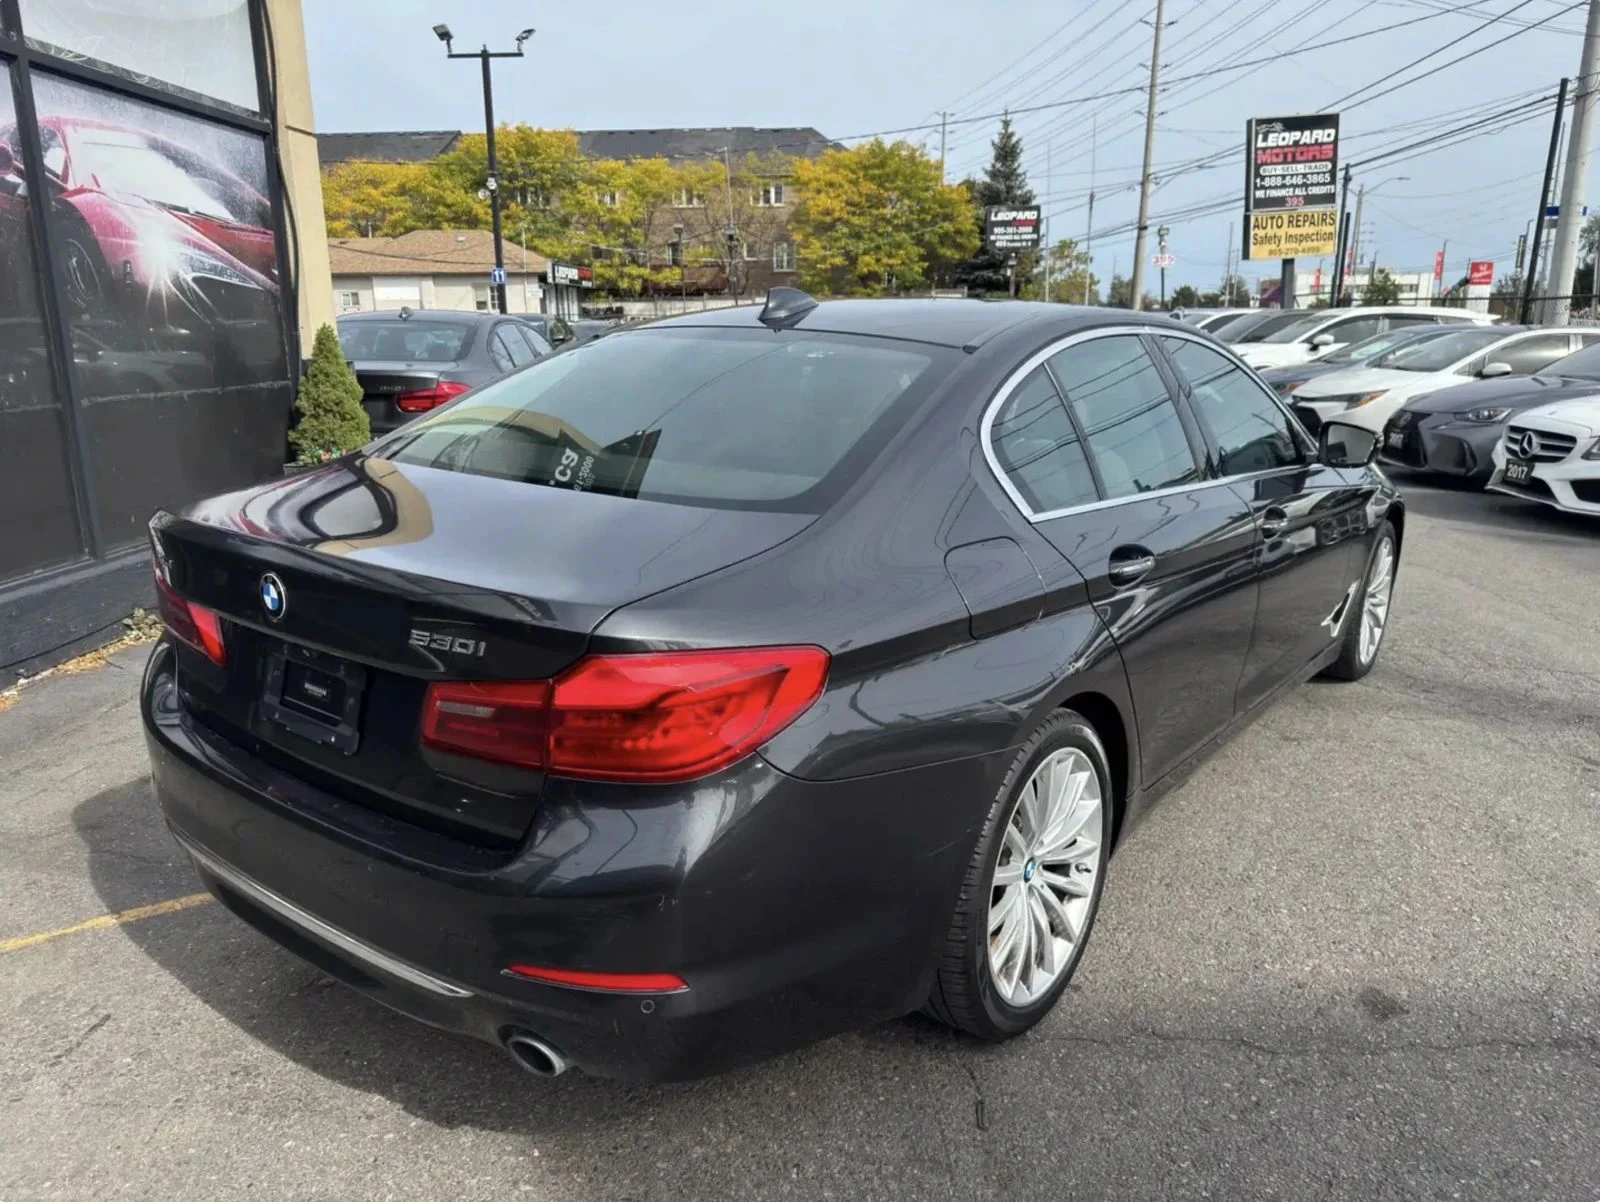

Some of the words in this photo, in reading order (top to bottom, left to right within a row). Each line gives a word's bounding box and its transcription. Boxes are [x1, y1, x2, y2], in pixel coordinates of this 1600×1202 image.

[1257, 129, 1335, 147] LEOPARD
[1256, 144, 1334, 164] MOTORS
[1255, 173, 1331, 188] 1-888-646-3865
[1255, 190, 1265, 199] WE
[1266, 187, 1294, 198] FINANCE
[1295, 186, 1307, 196] ALL
[1307, 185, 1335, 195] CREDITS
[1285, 197, 1305, 207] 395
[991, 211, 1038, 220] LEOPARD
[1253, 215, 1284, 231] AUTO
[1287, 212, 1335, 228] REPAIRS
[1252, 232, 1282, 248] Safety
[1284, 230, 1334, 246] Inspection
[494, 269, 505, 282] 11
[1507, 463, 1528, 480] 2017
